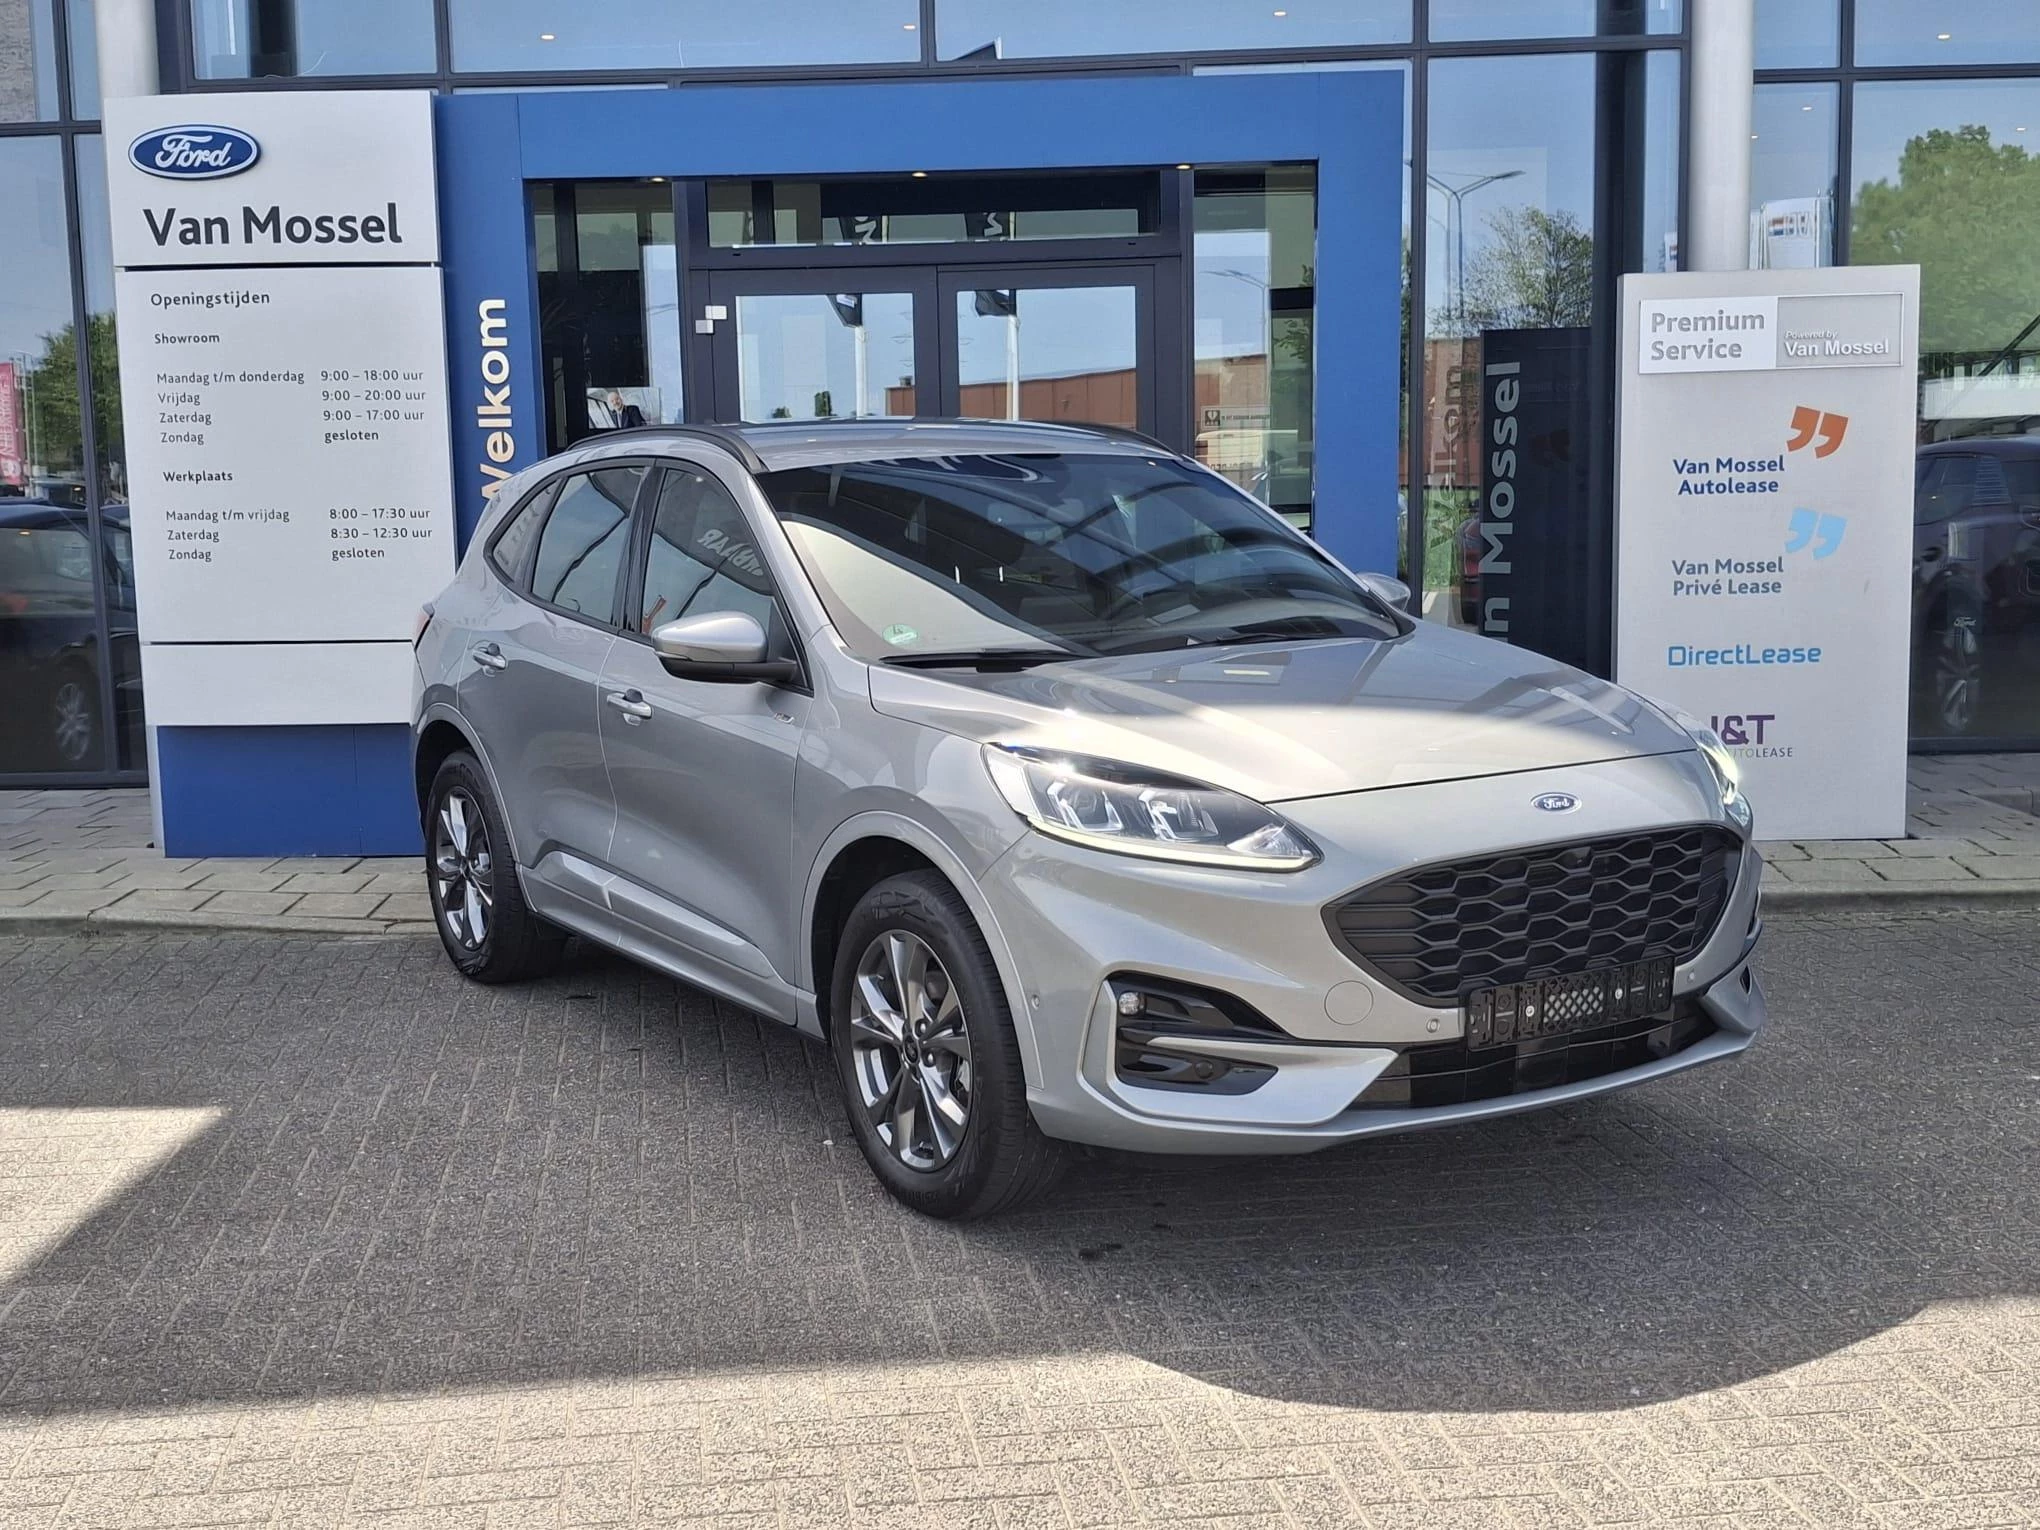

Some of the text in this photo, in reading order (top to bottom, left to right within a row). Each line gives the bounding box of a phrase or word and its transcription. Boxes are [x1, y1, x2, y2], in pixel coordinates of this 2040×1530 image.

[155, 134, 232, 168] Ford
[143, 202, 403, 246] Van Mossel
[150, 291, 270, 309] Openingstijden
[1650, 309, 1765, 333] Premium
[154, 333, 220, 344] Showroom
[1650, 338, 1742, 361] Service
[1785, 338, 1889, 357] Van Mossel
[157, 372, 210, 386] Maandag
[213, 371, 236, 383] t/m
[239, 370, 305, 384] donderdag
[320, 370, 350, 381] 9:00
[364, 370, 399, 381] 18:00
[403, 371, 424, 381] uur
[158, 392, 201, 406] Vrijdag
[322, 390, 351, 401] 9:00
[364, 389, 401, 401] 20:00
[405, 390, 426, 401] uur
[159, 412, 212, 426] Zaterdag
[323, 410, 352, 421] 9:00
[366, 410, 400, 421] 17:00
[404, 410, 425, 421] uur
[160, 430, 379, 446] Zondag gesloten
[1479, 362, 1520, 574] Mossel
[1673, 455, 1785, 474] Van Mossel
[163, 471, 233, 485] Werkplaats
[1678, 476, 1779, 495] Autolease
[166, 509, 219, 523] Maandag
[222, 509, 245, 521] t/m
[248, 508, 290, 524] vrijdag
[329, 508, 358, 520] 8:00
[371, 508, 405, 520] 17:30
[409, 509, 431, 519] uur
[167, 529, 220, 543] Zaterdag
[330, 528, 359, 539] 8:30
[373, 527, 408, 539] 12:30
[412, 528, 432, 538] uur
[169, 547, 385, 563] Zondag gesloten
[1672, 556, 1784, 575] Van Mossel
[1673, 579, 1782, 596] Privé Lease
[1668, 645, 1822, 666] DirectLease
[1728, 747, 1793, 758] TOLEASE
